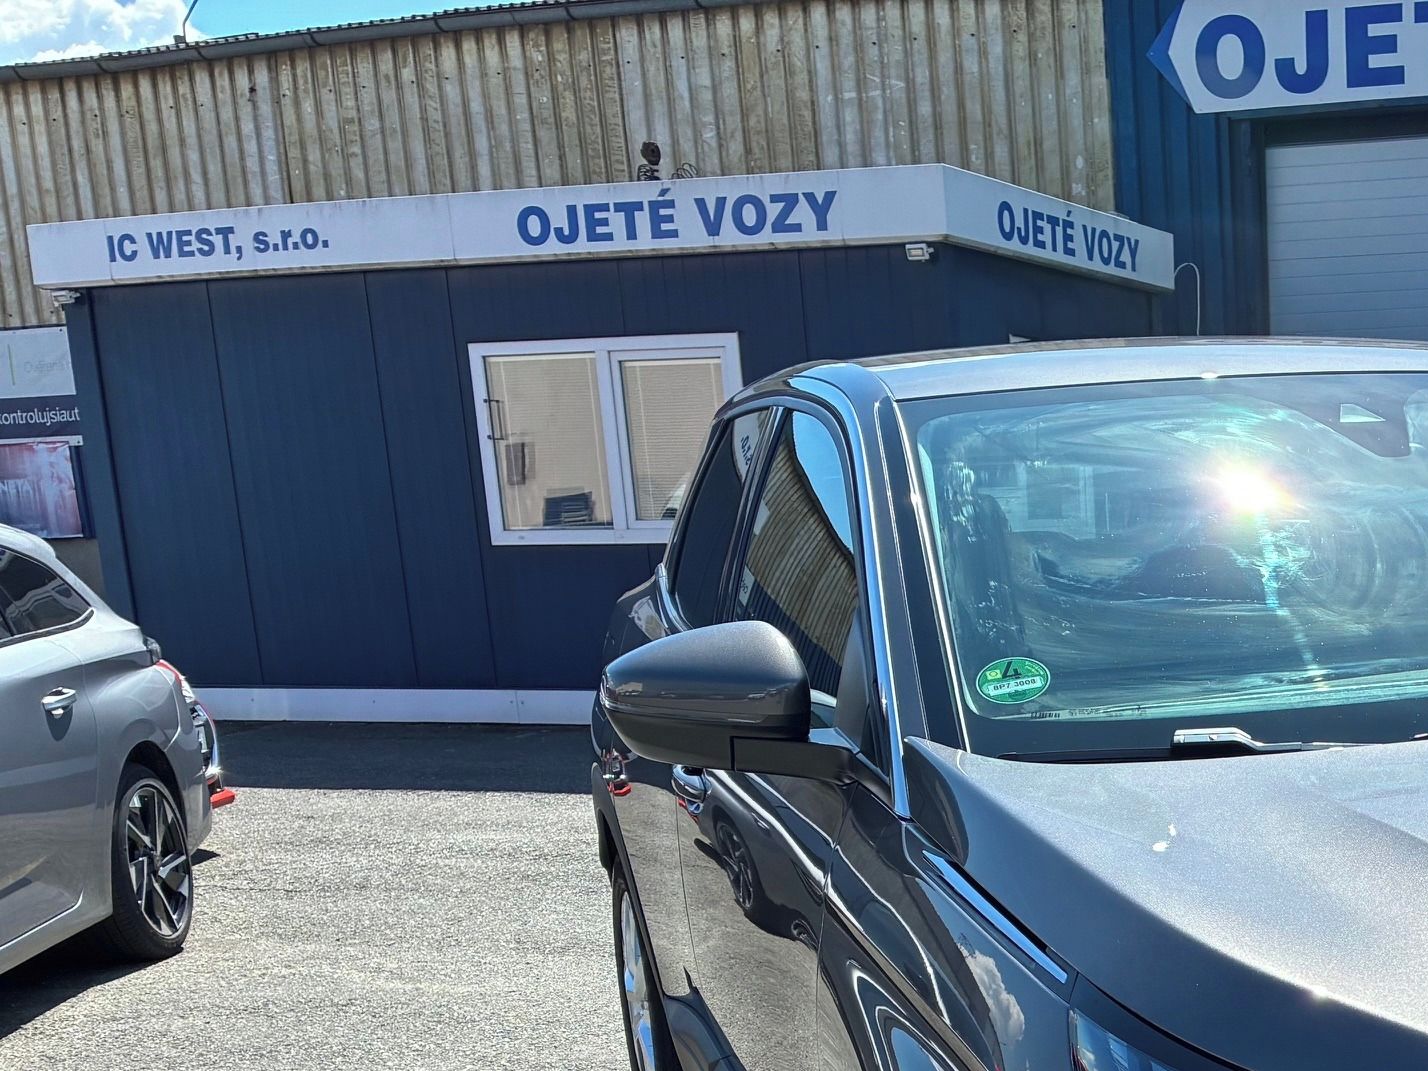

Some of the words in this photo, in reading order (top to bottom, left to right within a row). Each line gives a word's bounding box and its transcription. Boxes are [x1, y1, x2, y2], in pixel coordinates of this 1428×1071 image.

[516, 187, 679, 247] OJETÉ
[693, 190, 837, 237] VOZY
[997, 200, 1076, 257] OJETÉ
[1082, 224, 1139, 272] VOZY
[106, 233, 138, 263] IC
[146, 226, 243, 261] WEST,
[253, 227, 330, 254] s.r.o.
[1002, 660, 1022, 679] 4
